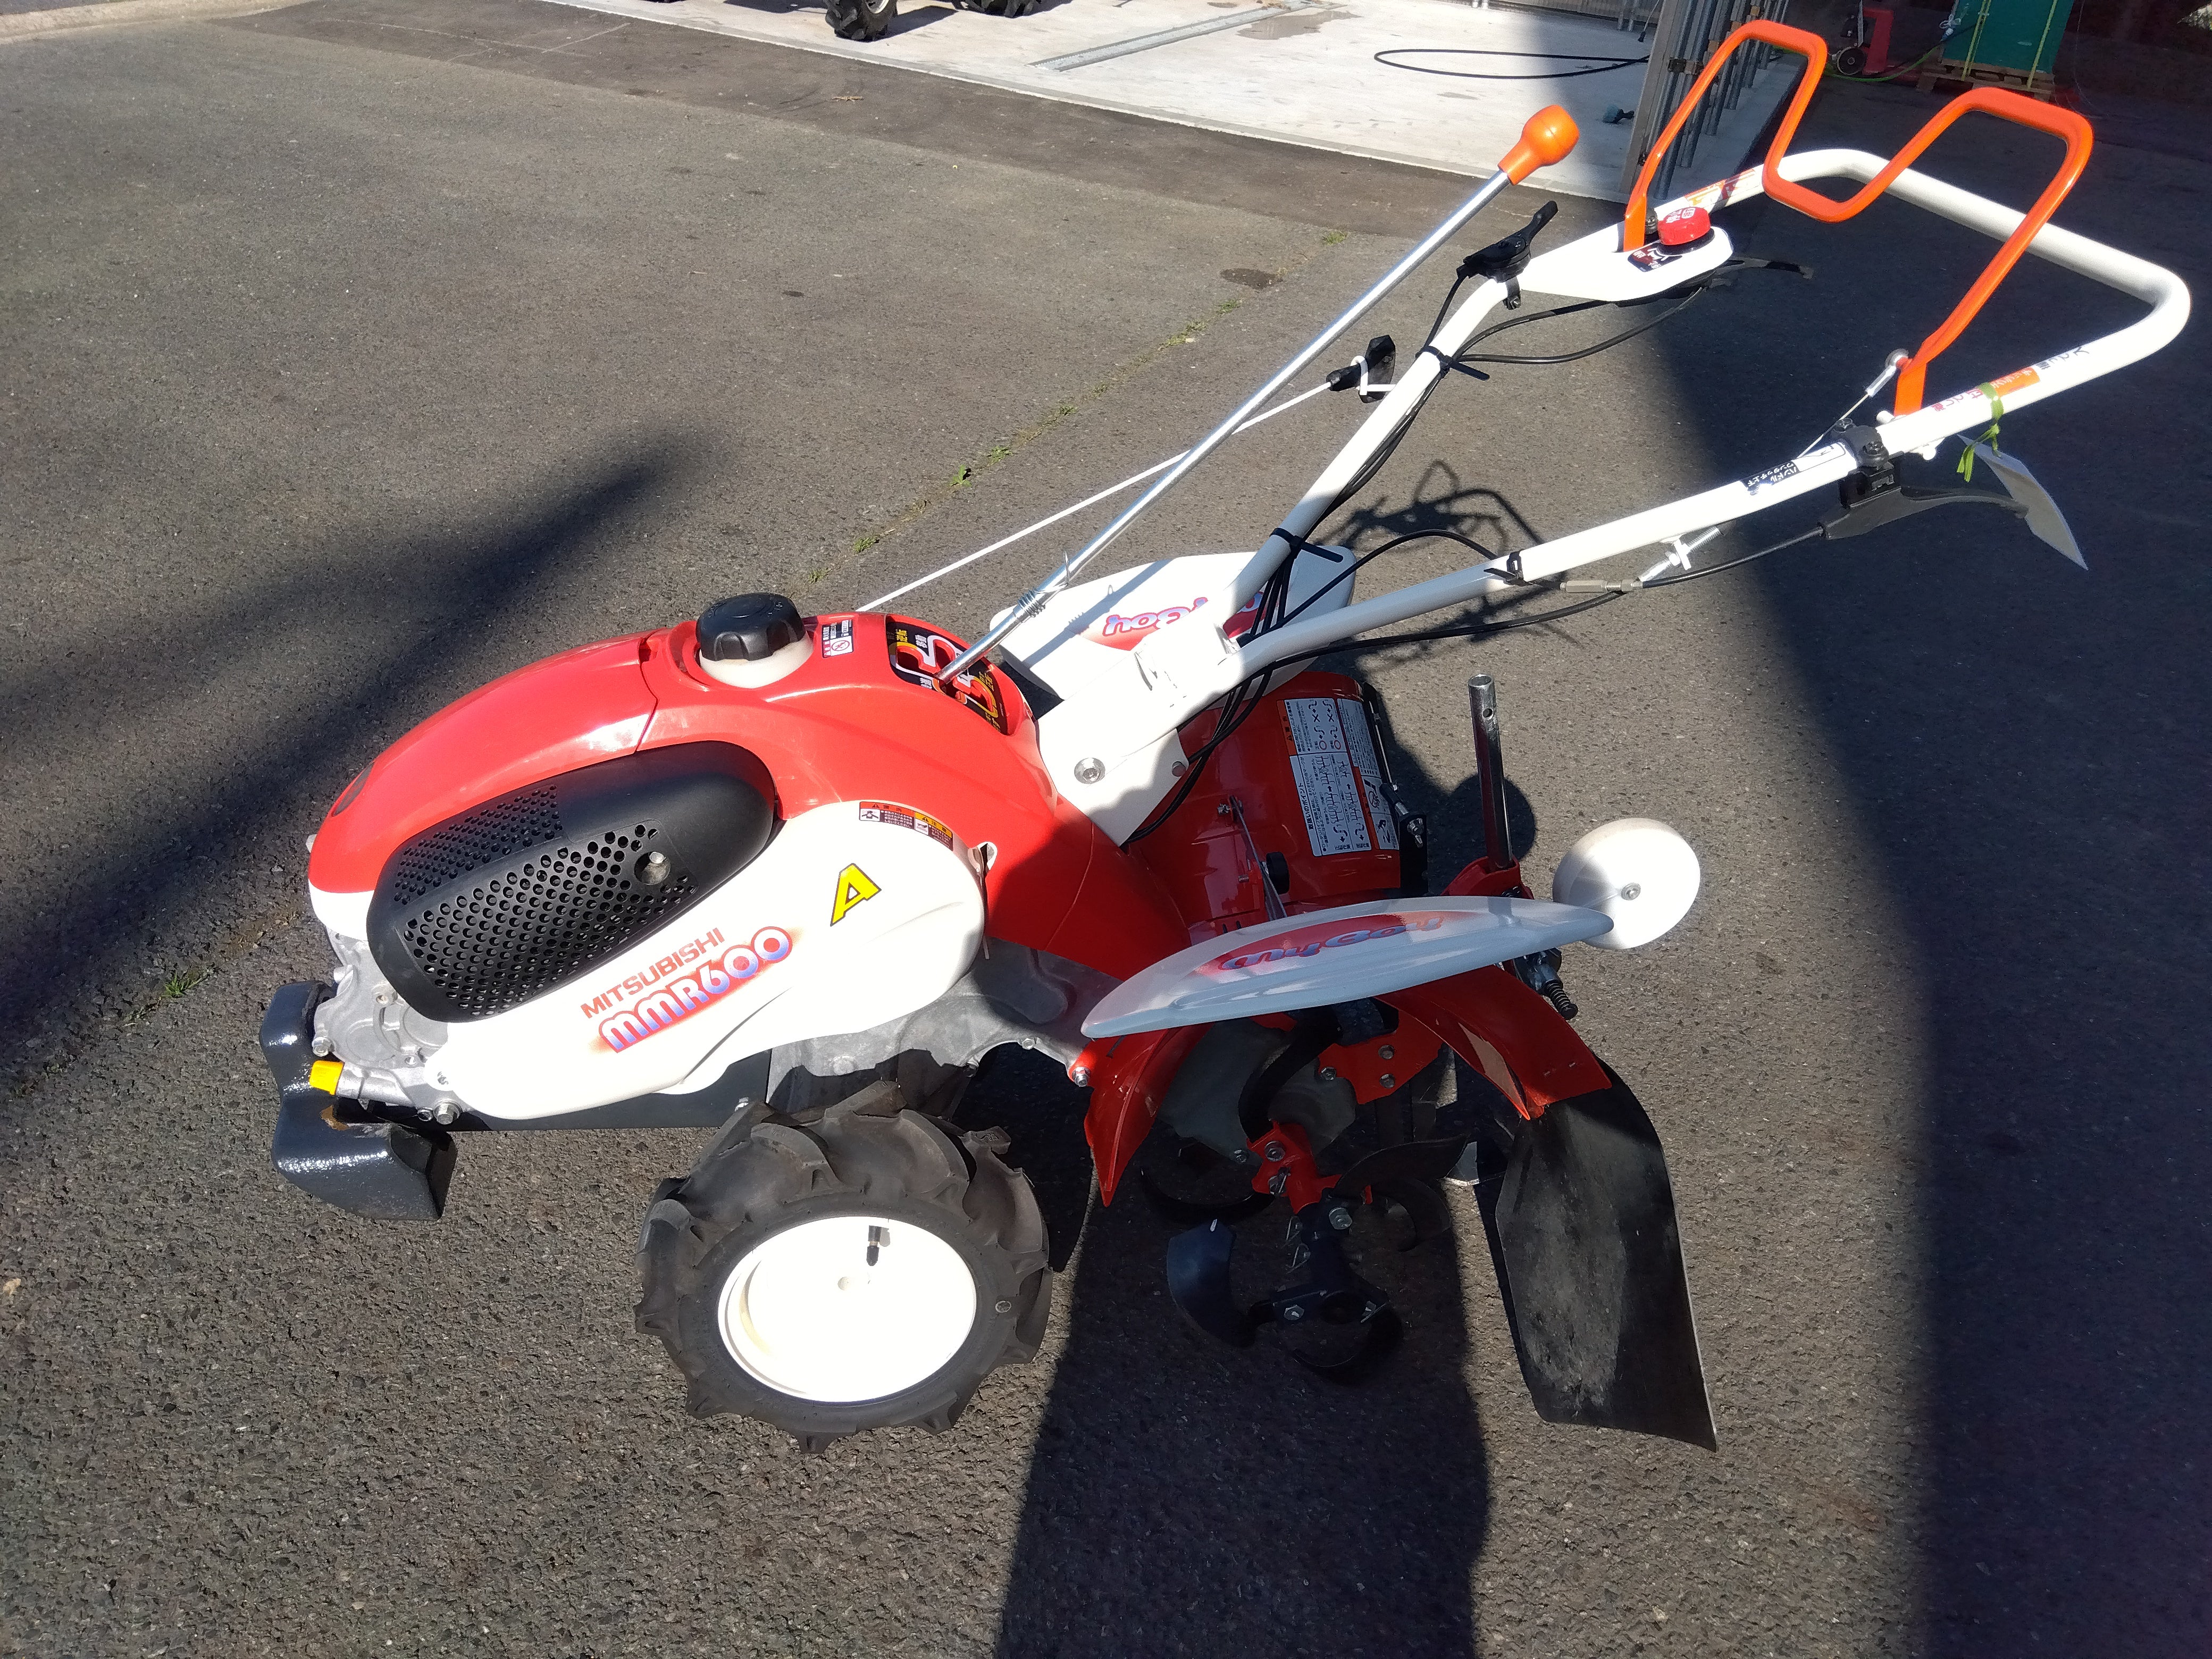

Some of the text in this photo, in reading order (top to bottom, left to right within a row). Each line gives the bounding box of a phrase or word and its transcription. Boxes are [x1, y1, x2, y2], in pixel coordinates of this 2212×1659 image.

[1747, 462, 1794, 487] ワンタッチ上下
[1770, 466, 1798, 483] ハンドル
[1299, 784, 1313, 830] 取扱いのポイント
[830, 863, 882, 926] A
[581, 927, 725, 1018] MITSUBISHI
[599, 926, 792, 1053] MMR600
